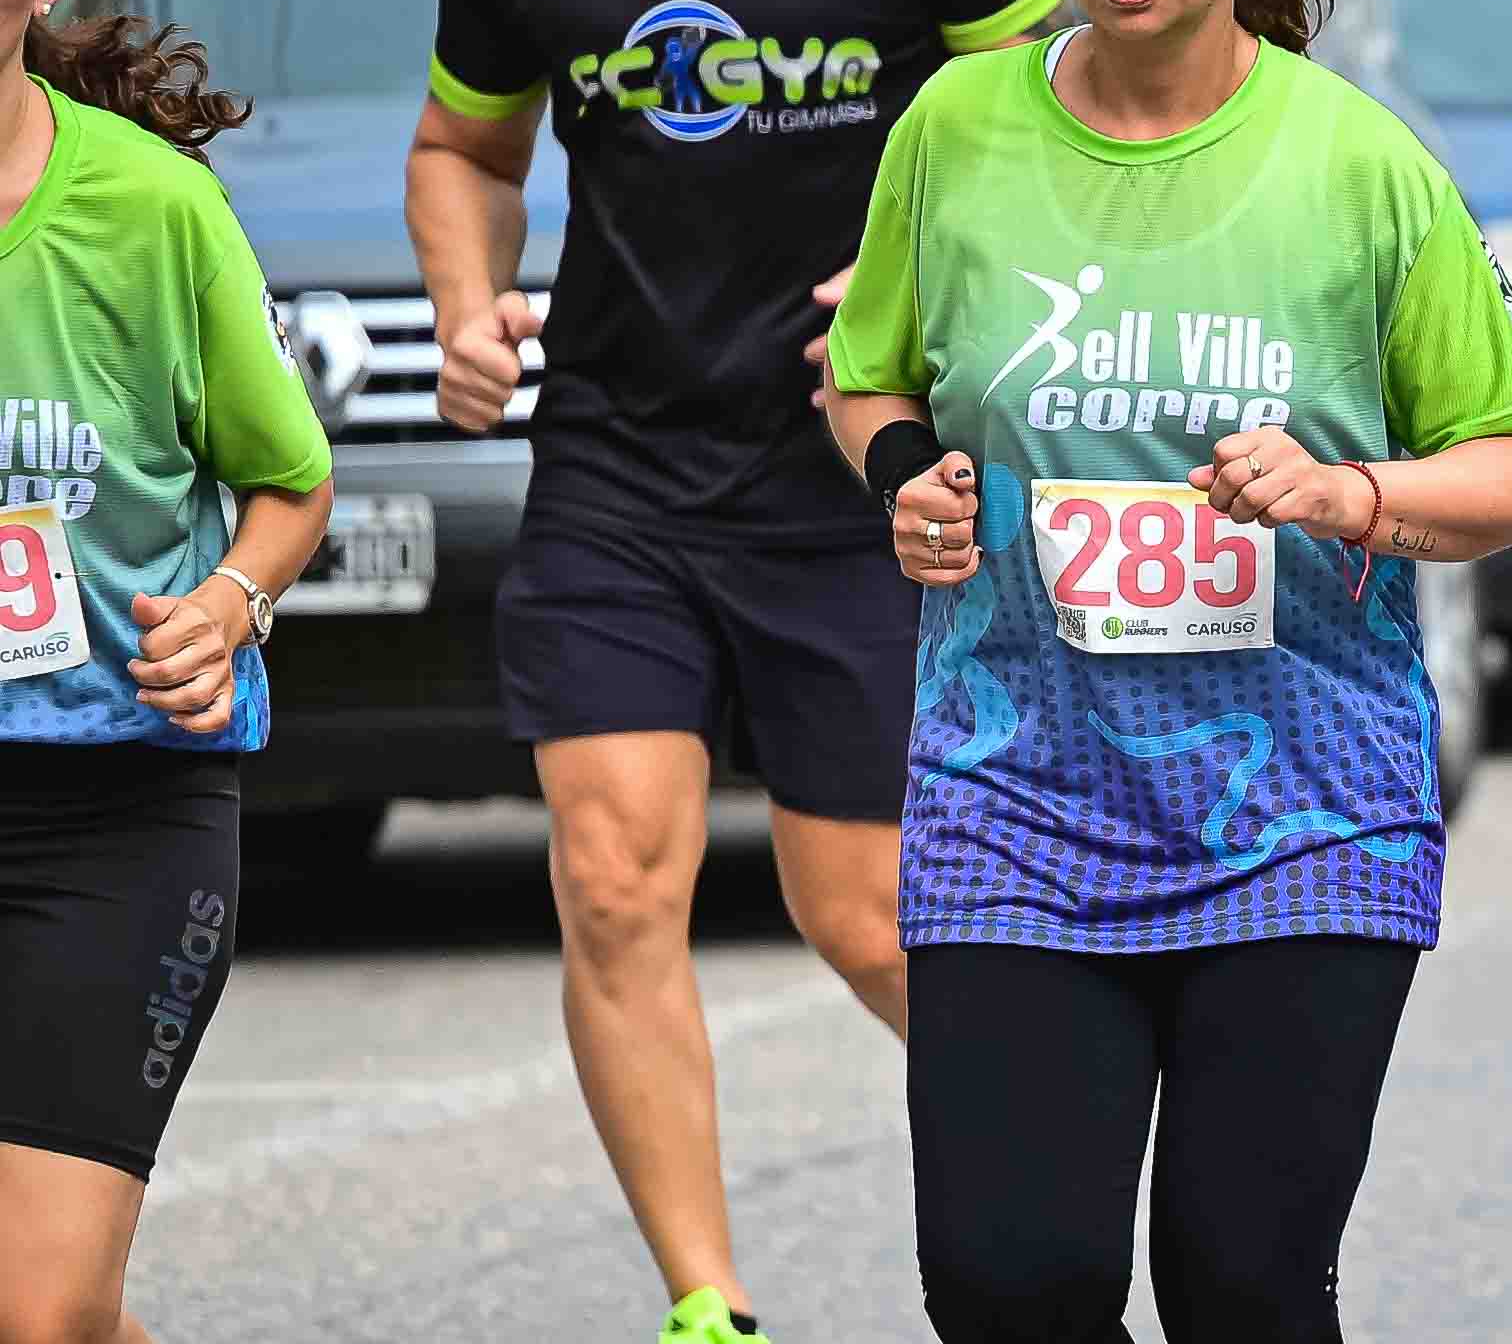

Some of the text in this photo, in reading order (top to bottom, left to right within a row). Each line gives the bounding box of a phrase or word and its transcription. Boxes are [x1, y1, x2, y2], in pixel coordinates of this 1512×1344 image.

[1176, 311, 1295, 394] Ville
[1026, 386, 1292, 435] corre
[1049, 498, 1257, 608] 285
[1125, 618, 1150, 629] CLUB
[1186, 621, 1257, 637] CARUSO
[0, 640, 70, 663] CARUSO
[143, 888, 225, 1088] adidas
